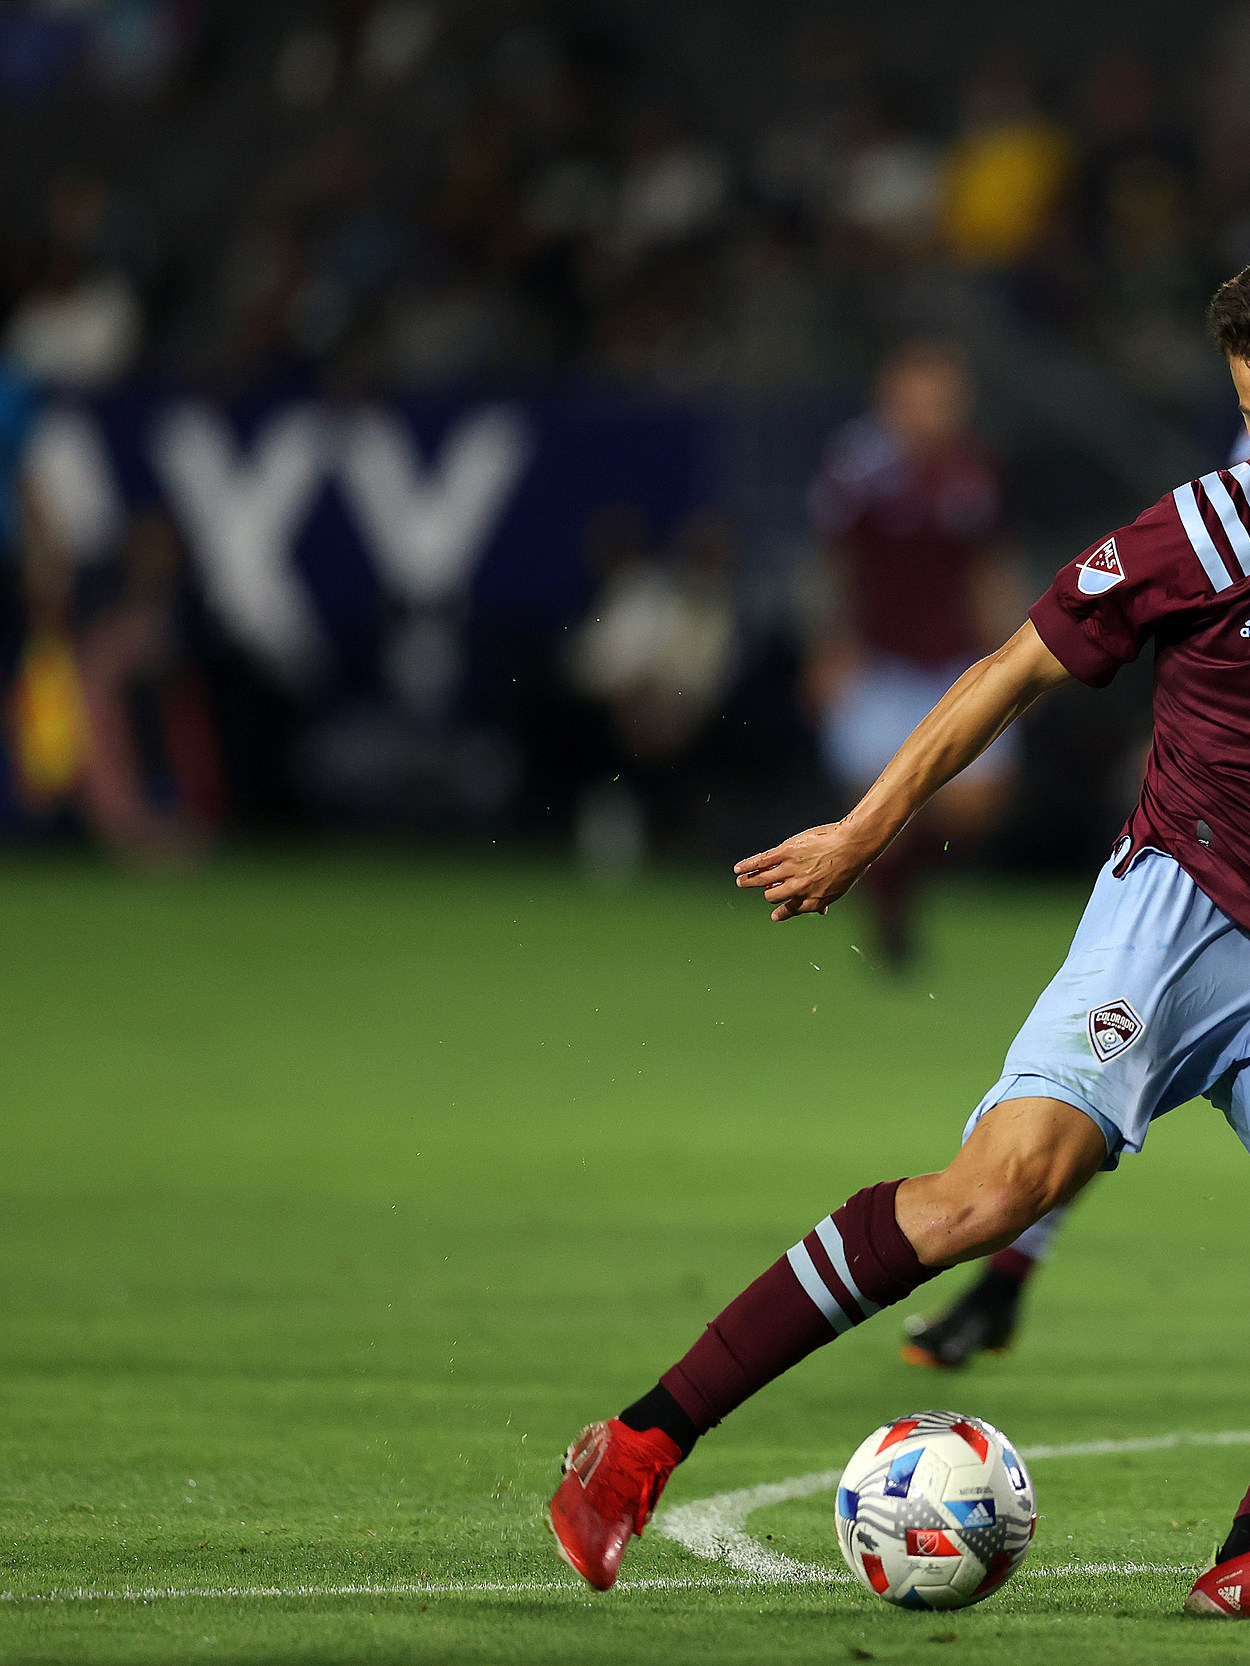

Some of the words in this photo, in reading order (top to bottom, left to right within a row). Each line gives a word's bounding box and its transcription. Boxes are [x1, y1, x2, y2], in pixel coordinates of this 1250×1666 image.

[1103, 543, 1116, 570] MLS
[1095, 1011, 1136, 1032] COLORADO
[1217, 1587, 1242, 1611] adidas
